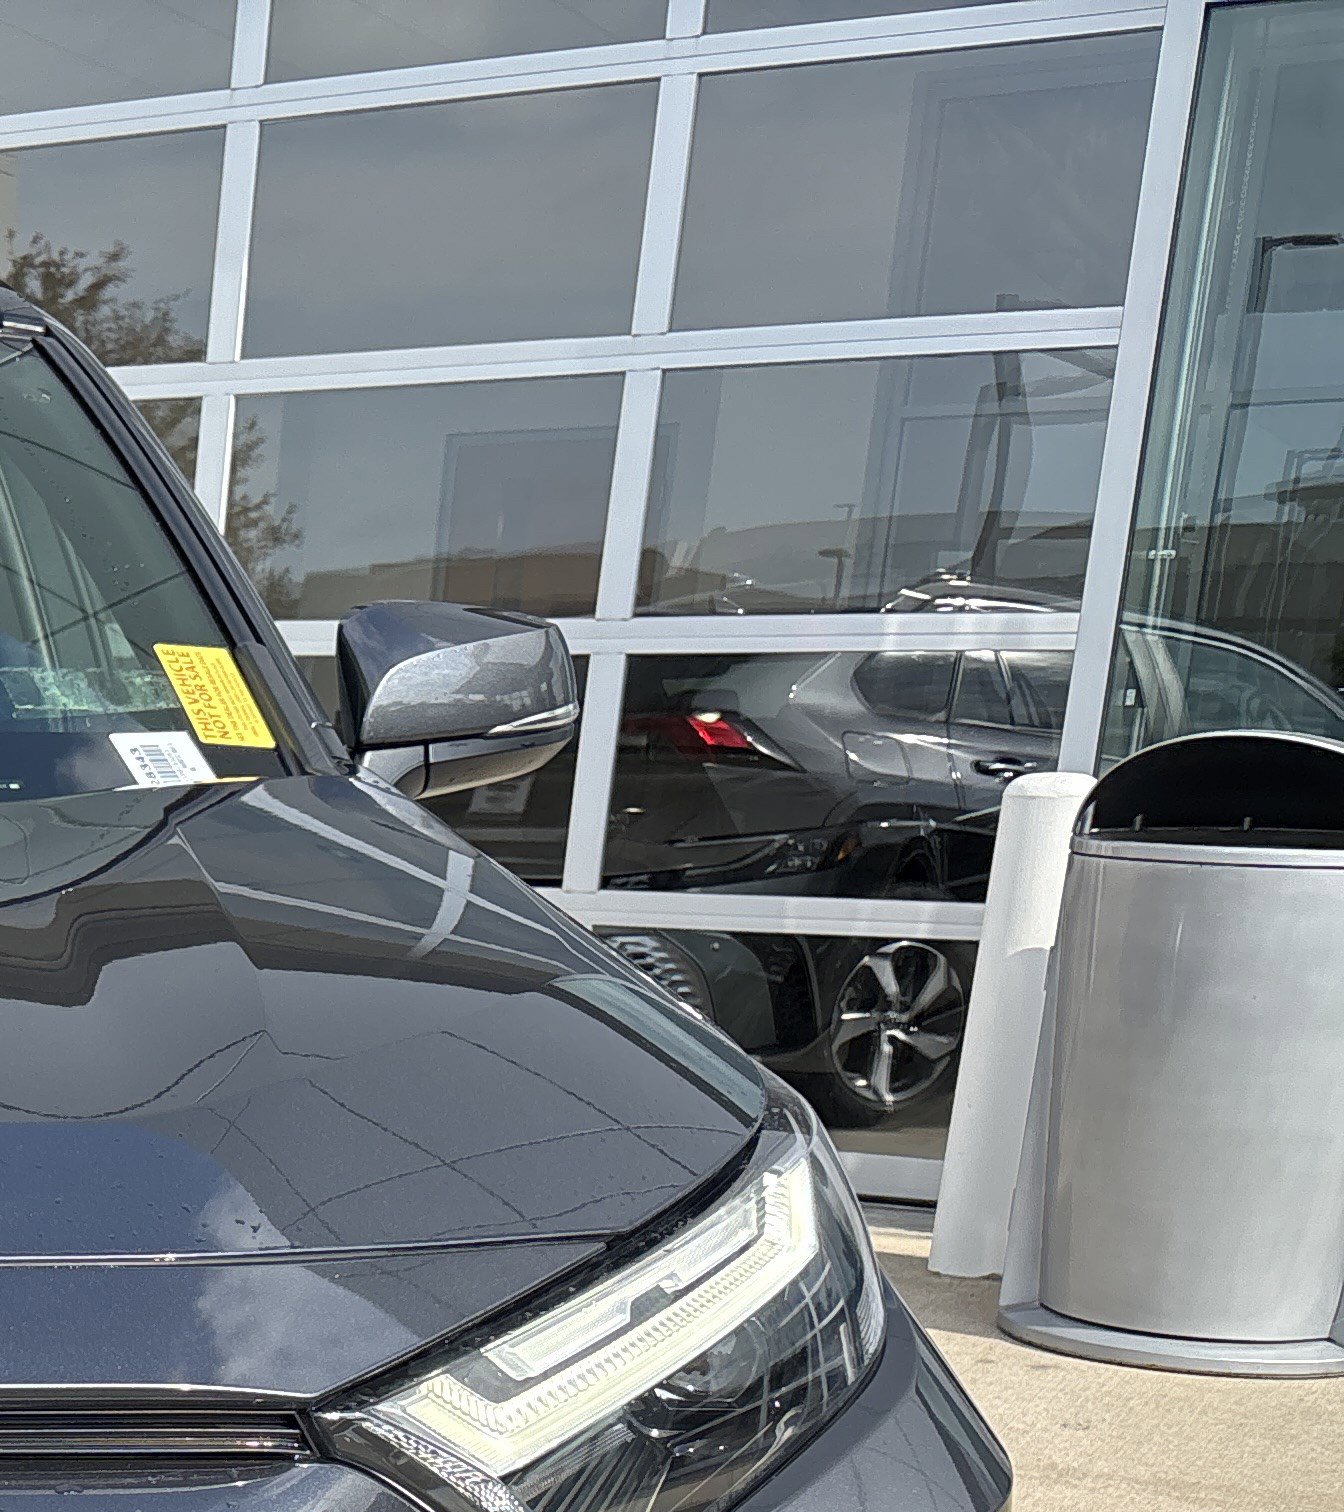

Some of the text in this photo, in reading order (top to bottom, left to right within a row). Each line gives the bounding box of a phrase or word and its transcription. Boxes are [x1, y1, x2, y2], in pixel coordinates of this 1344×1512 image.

[161, 649, 200, 706] VEHICLE
[176, 651, 203, 681] SALE
[194, 684, 217, 710] FOR
[191, 709, 217, 740] THIS
[208, 712, 232, 740] NOT
